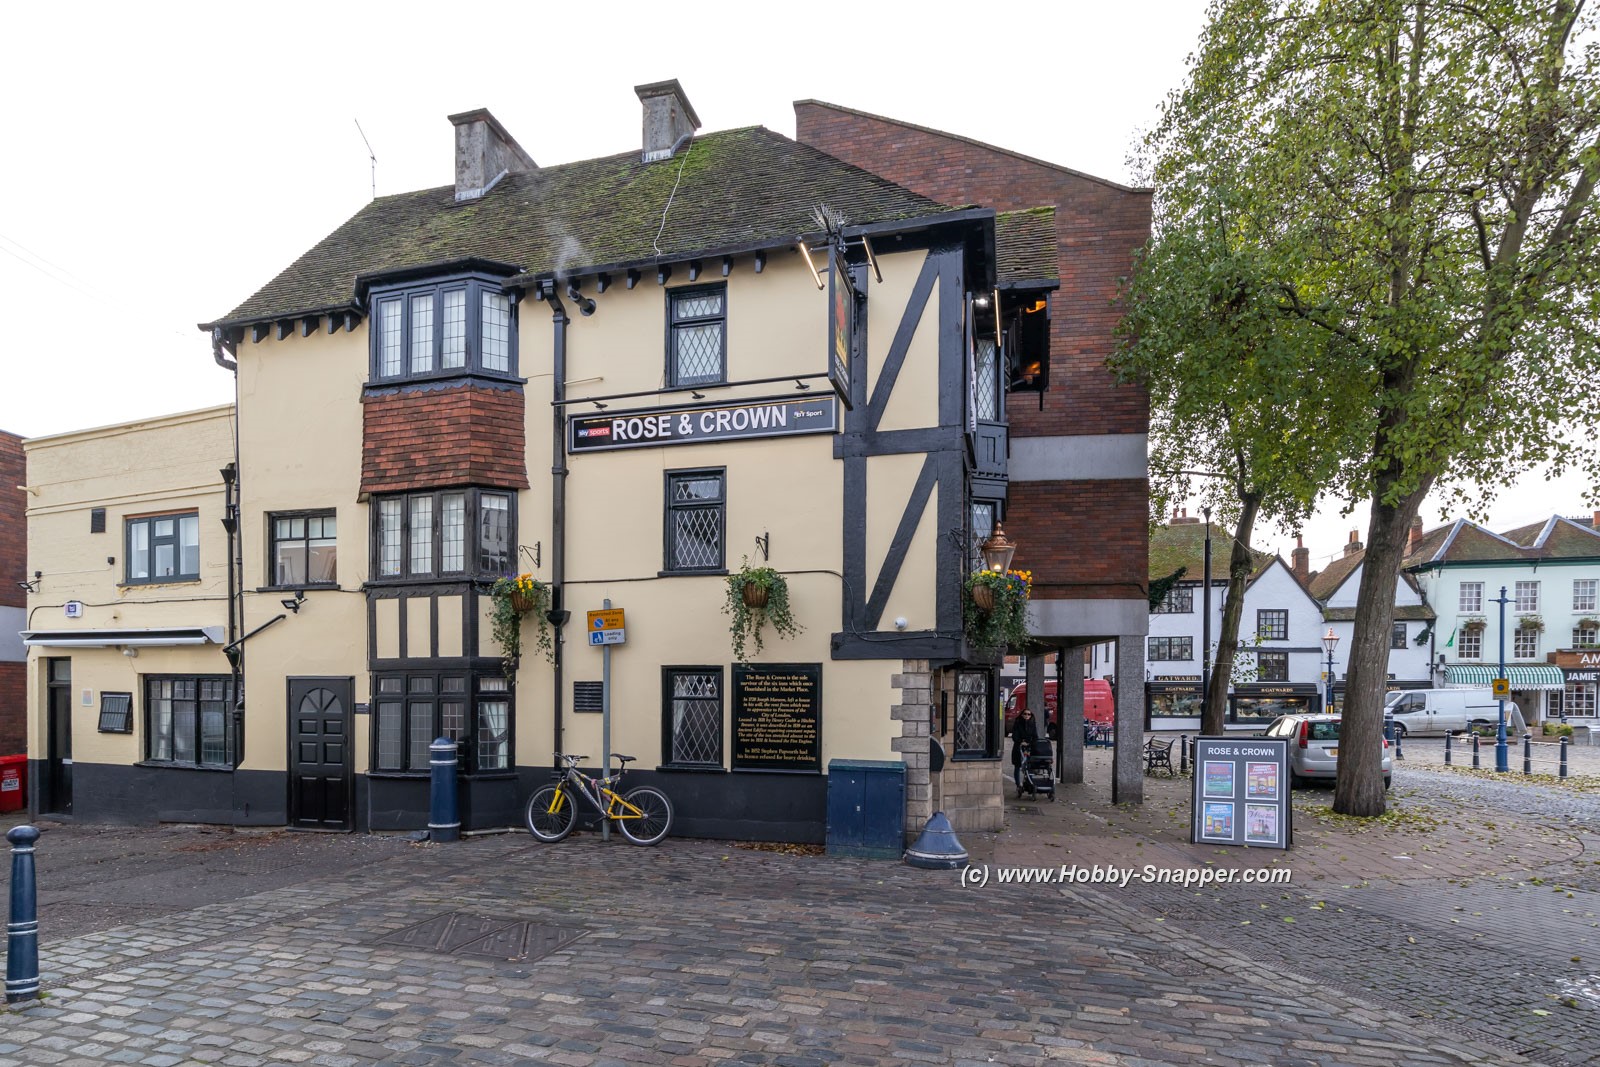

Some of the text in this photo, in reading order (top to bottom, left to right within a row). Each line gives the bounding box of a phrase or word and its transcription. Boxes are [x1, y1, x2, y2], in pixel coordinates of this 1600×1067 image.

[806, 410, 822, 418] Sport
[612, 405, 787, 441] ROSE & CROWN
[578, 427, 609, 438] sky sports
[1208, 747, 1275, 756] ROSE & CROWN
